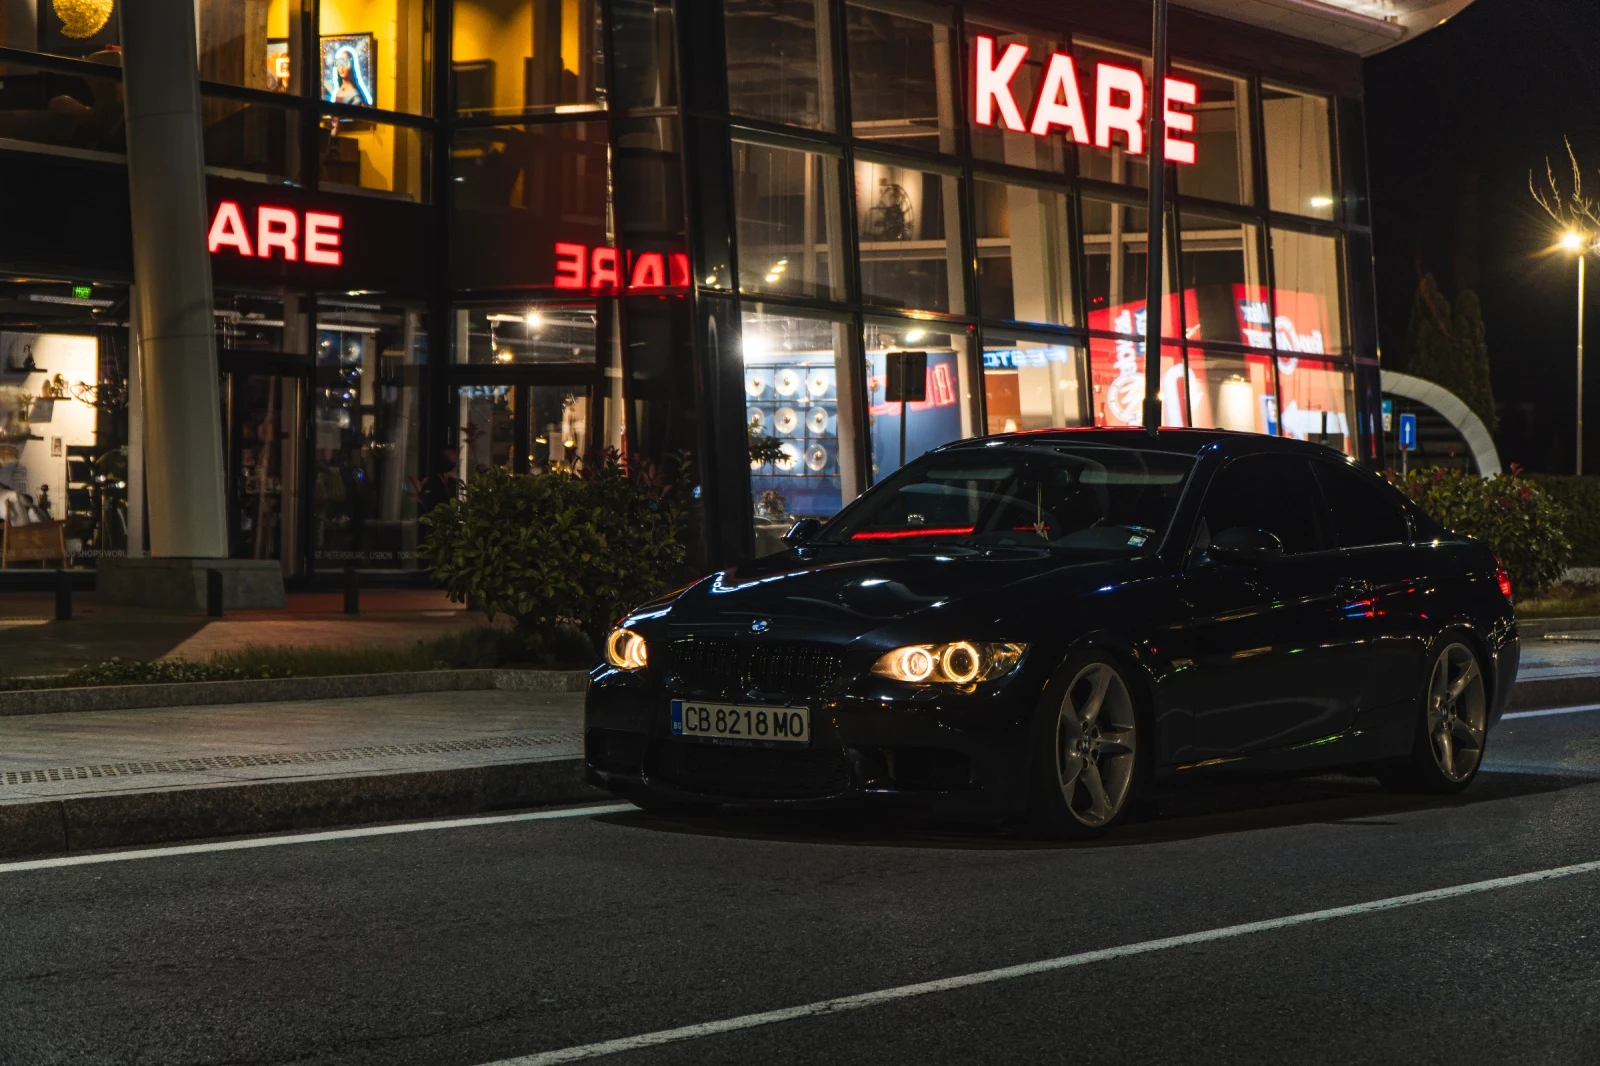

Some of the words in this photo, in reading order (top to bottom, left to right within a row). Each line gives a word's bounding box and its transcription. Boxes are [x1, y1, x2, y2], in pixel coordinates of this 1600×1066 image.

[975, 35, 1198, 164] KARE
[208, 202, 341, 265] ARE
[673, 721, 682, 730] BG
[685, 707, 711, 732] CB
[715, 708, 768, 736] 8218
[773, 711, 804, 737] MO
